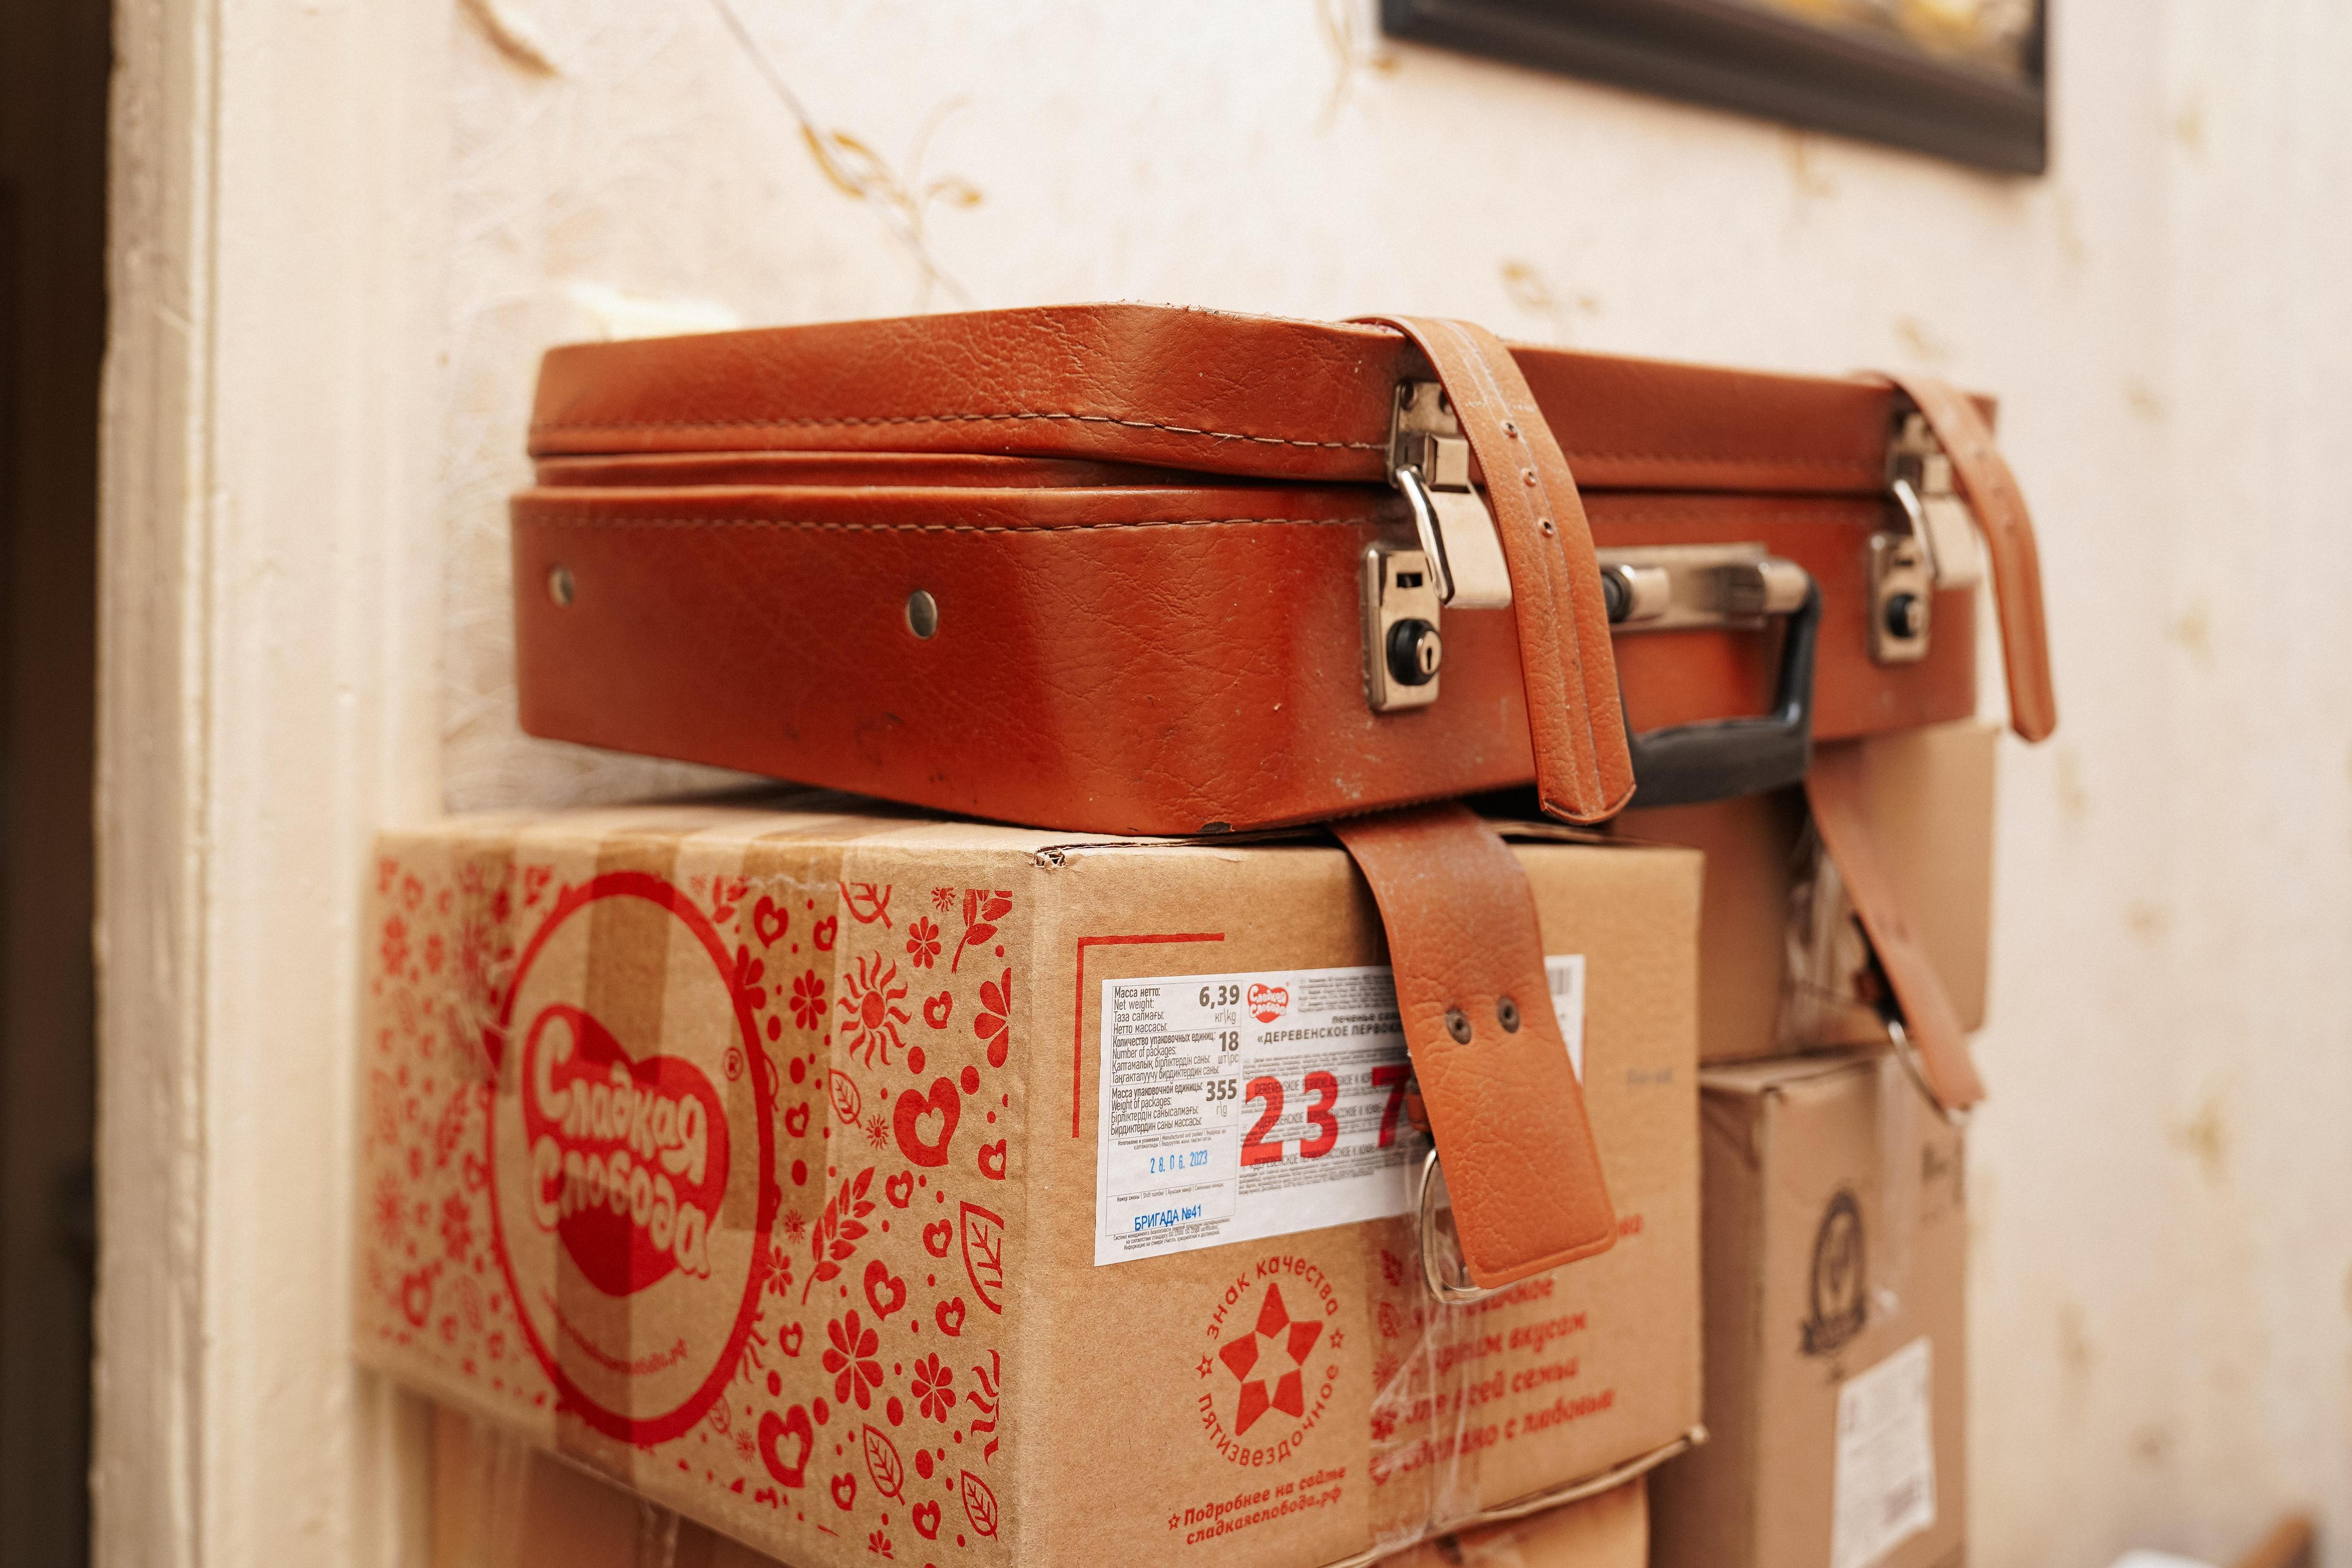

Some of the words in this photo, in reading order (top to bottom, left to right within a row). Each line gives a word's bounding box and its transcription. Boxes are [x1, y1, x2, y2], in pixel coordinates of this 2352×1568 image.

[1114, 987, 1137, 998] Масса
[1140, 987, 1160, 997] нетто:
[1199, 984, 1240, 1009] 6,39
[1114, 999, 1126, 1011] Net
[1129, 998, 1154, 1012] weight:
[1114, 1011, 1129, 1022] Таза
[1132, 1011, 1164, 1021] салмағы:
[1113, 1023, 1133, 1035] Нетто
[1135, 1023, 1168, 1034] массасы:
[1112, 1035, 1148, 1049] Количество
[1150, 1033, 1191, 1048] упаковочных
[1192, 1031, 1216, 1043] единиц:
[1219, 1030, 1240, 1052] 18
[1112, 1048, 1137, 1060] Number
[1139, 1046, 1145, 1058] of
[1146, 1045, 1177, 1059] packages:
[1112, 1088, 1132, 1099] Масса
[1134, 1082, 1173, 1100] упаковочной
[1175, 1082, 1203, 1094] единицы:
[1206, 1078, 1237, 1102] 355
[535, 1014, 707, 1186] Сладкая
[1112, 1098, 1133, 1112] Weight
[1134, 1098, 1140, 1109] of
[1141, 1096, 1172, 1111] packages:
[1157, 1120, 1173, 1130] саны
[1175, 1116, 1202, 1128] массасы:
[1134, 1208, 1179, 1232] БРИГАДА
[1181, 1203, 1201, 1221] №41
[1183, 1488, 1271, 1526] Подробнее
[1275, 1481, 1294, 1498] на
